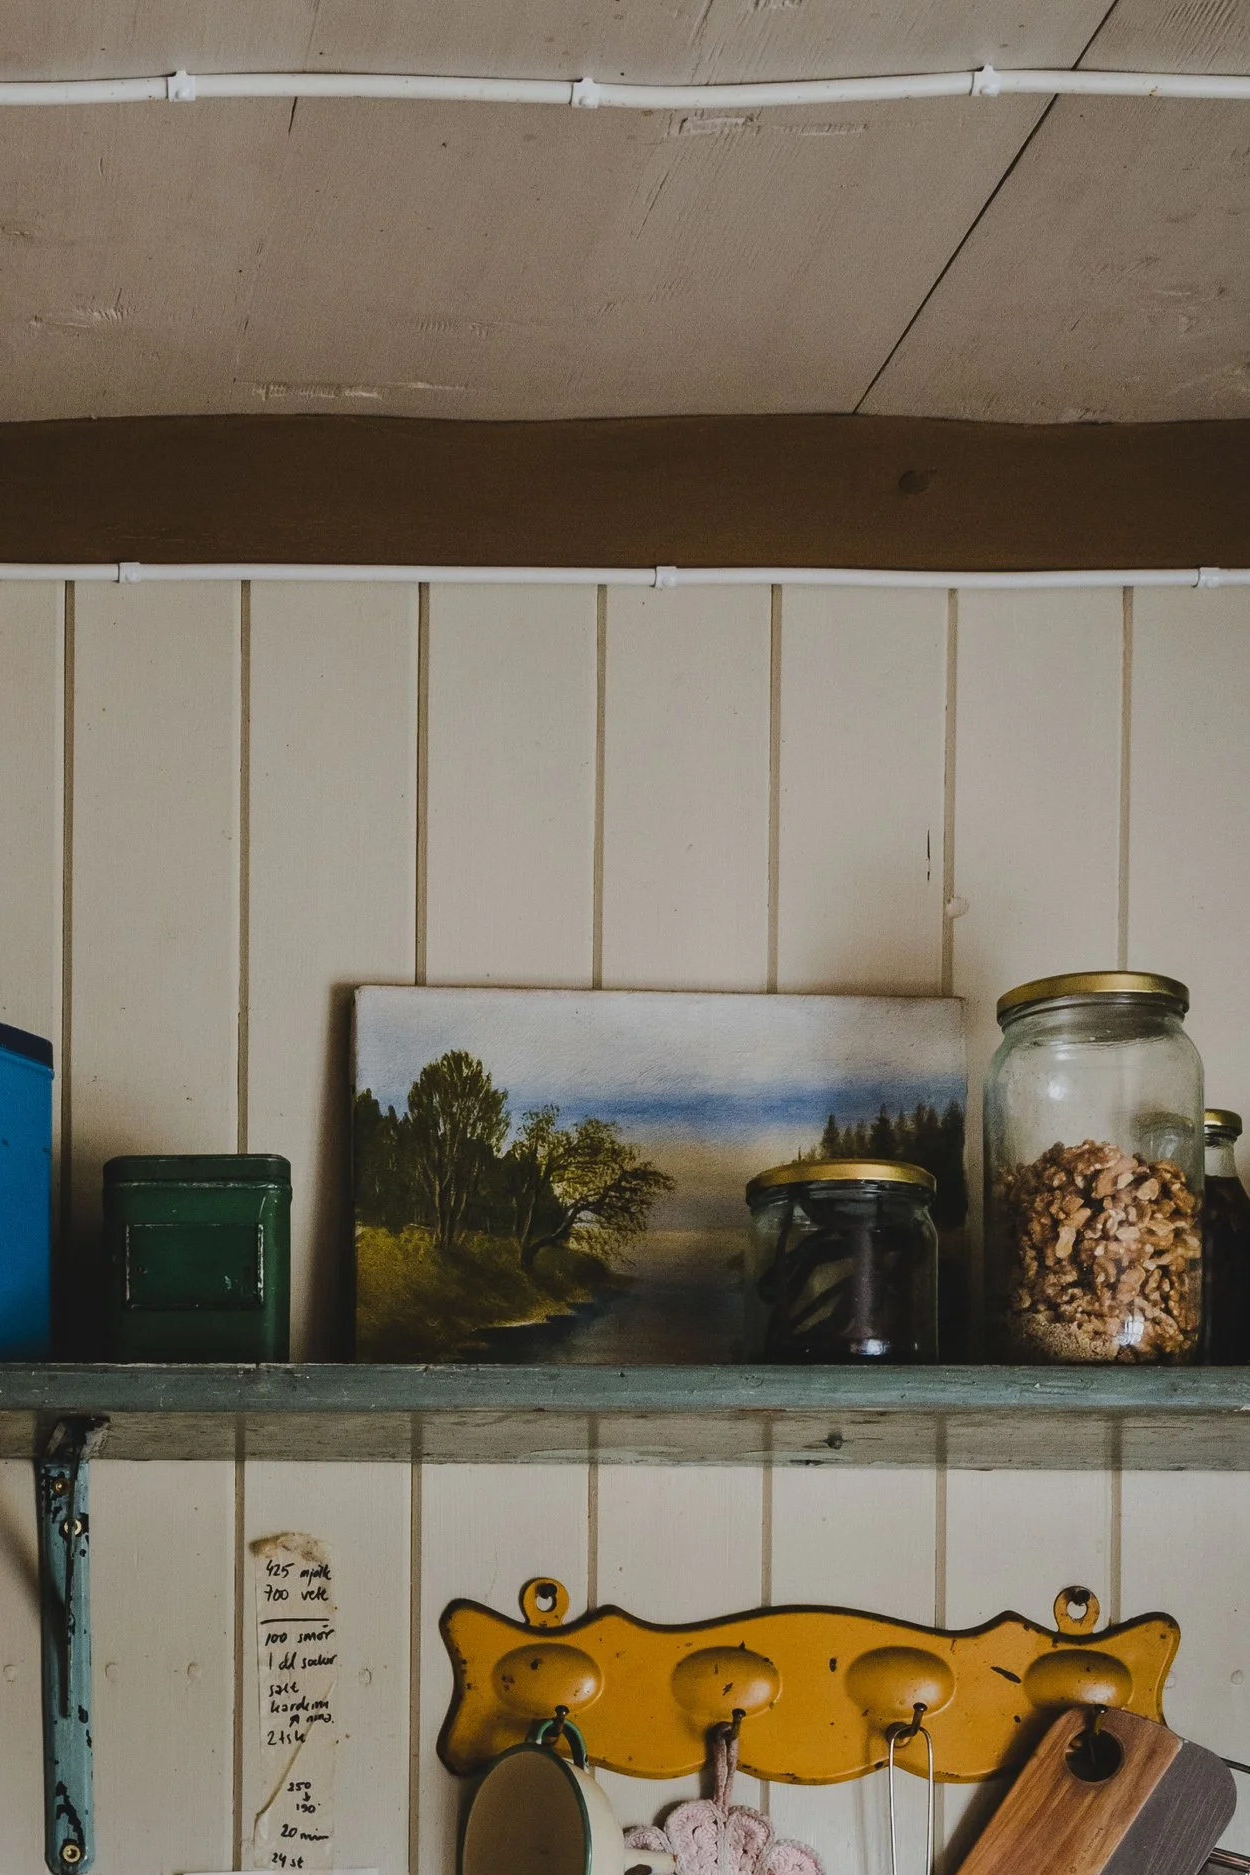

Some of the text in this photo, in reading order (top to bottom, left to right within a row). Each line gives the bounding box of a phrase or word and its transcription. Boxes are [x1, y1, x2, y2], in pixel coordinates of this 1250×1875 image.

[266, 1560, 295, 1578] 425
[264, 1584, 329, 1601] 700 vete
[265, 1625, 334, 1646] 100 smör
[279, 1652, 297, 1670] dl
[281, 1824, 297, 1837] 20
[272, 1852, 286, 1868] 24
